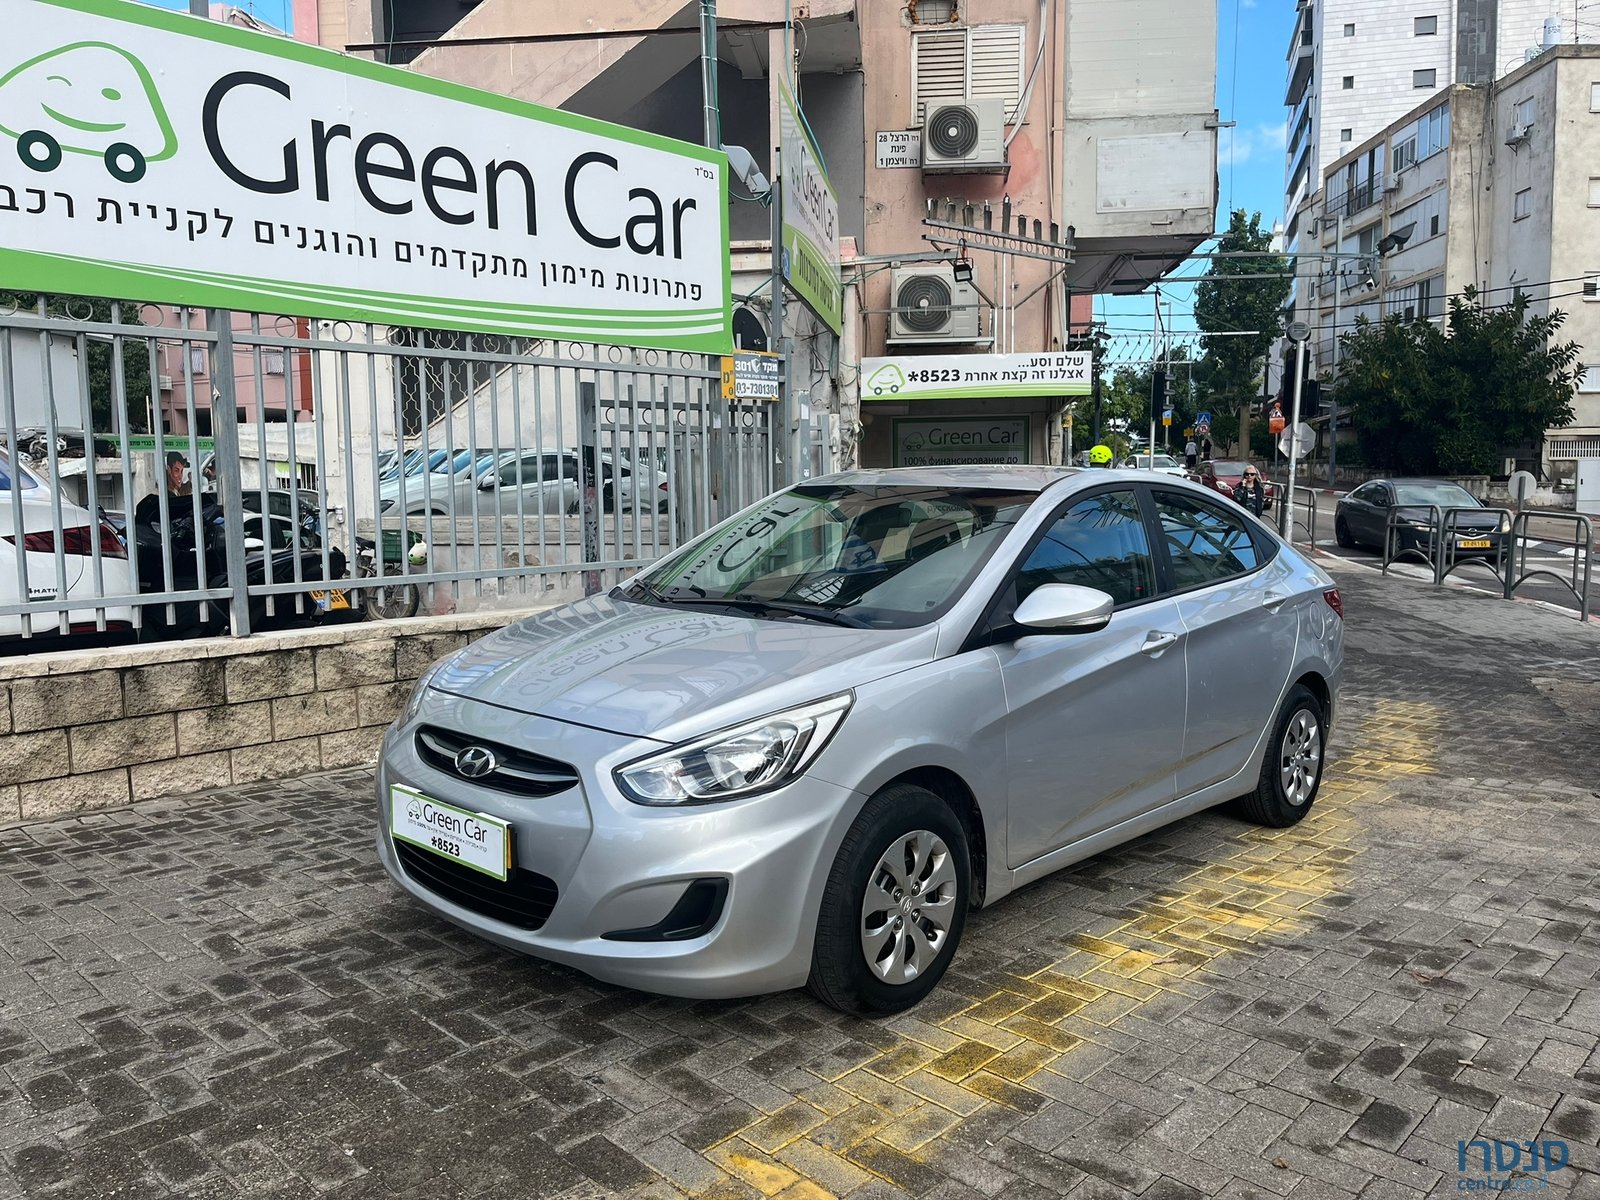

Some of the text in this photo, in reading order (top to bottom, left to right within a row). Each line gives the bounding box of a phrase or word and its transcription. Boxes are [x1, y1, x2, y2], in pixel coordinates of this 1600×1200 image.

[890, 133, 909, 142] הרצל
[891, 145, 906, 153] פינת
[202, 70, 697, 260] Green Car
[694, 167, 714, 180] בס"ד
[0, 184, 702, 301] פתרונות מימון מתקדמים והוגנים לקניית רכב
[735, 360, 751, 371] 301
[1017, 355, 1084, 368] שלם וסע...
[964, 371, 998, 381] אחרת
[1002, 370, 1027, 382] קצת
[1031, 370, 1045, 379] זה
[1050, 367, 1084, 379] אצלנו
[736, 382, 778, 396] 03-7301301
[928, 426, 1019, 446] Green Car
[903, 455, 1018, 466] 100% финансирование до
[423, 803, 488, 843] Green Car
